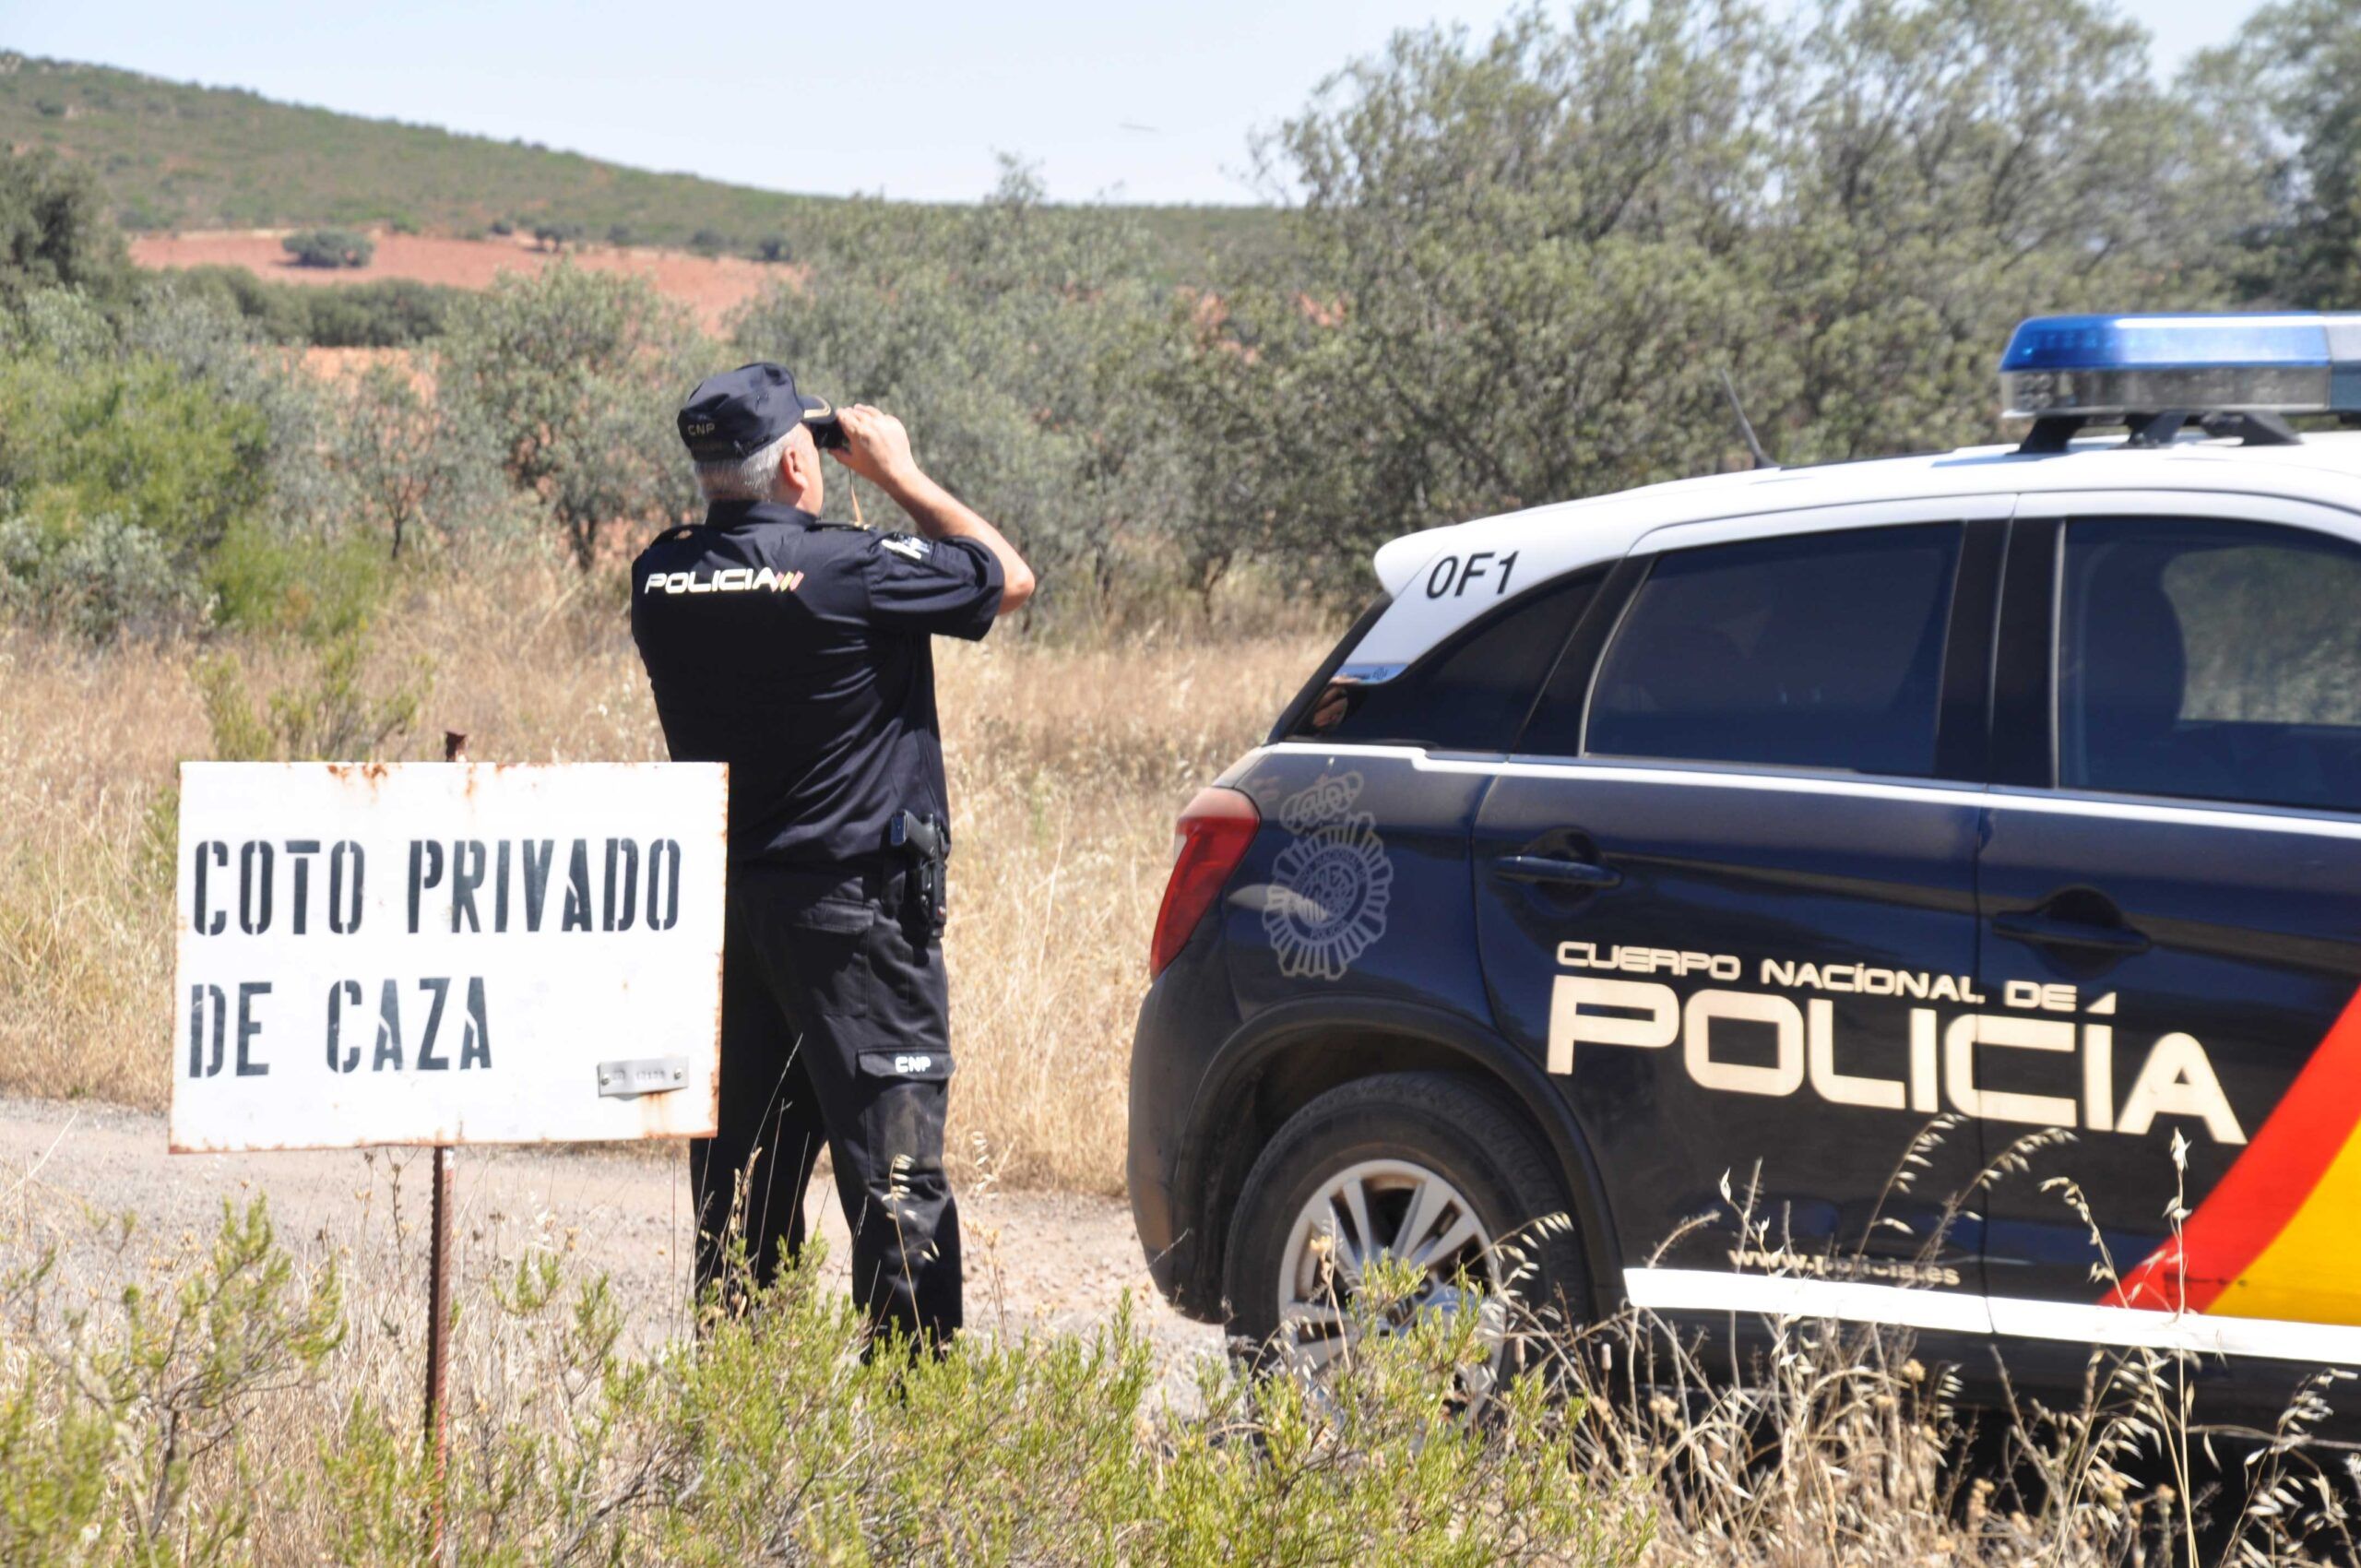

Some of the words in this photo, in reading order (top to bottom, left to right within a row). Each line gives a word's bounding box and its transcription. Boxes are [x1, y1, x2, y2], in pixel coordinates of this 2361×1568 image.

[687, 422, 715, 436] CNP
[645, 566, 779, 594] POLICIA
[194, 840, 365, 936] COTO
[408, 838, 681, 933] PRIVADO
[1557, 941, 1740, 980] CUERPO
[2004, 980, 2077, 1012] DE
[189, 981, 272, 1078] DE
[326, 977, 492, 1074] CAZA
[1547, 974, 2248, 1146] POLICÍA
[895, 1056, 931, 1073] CNP
